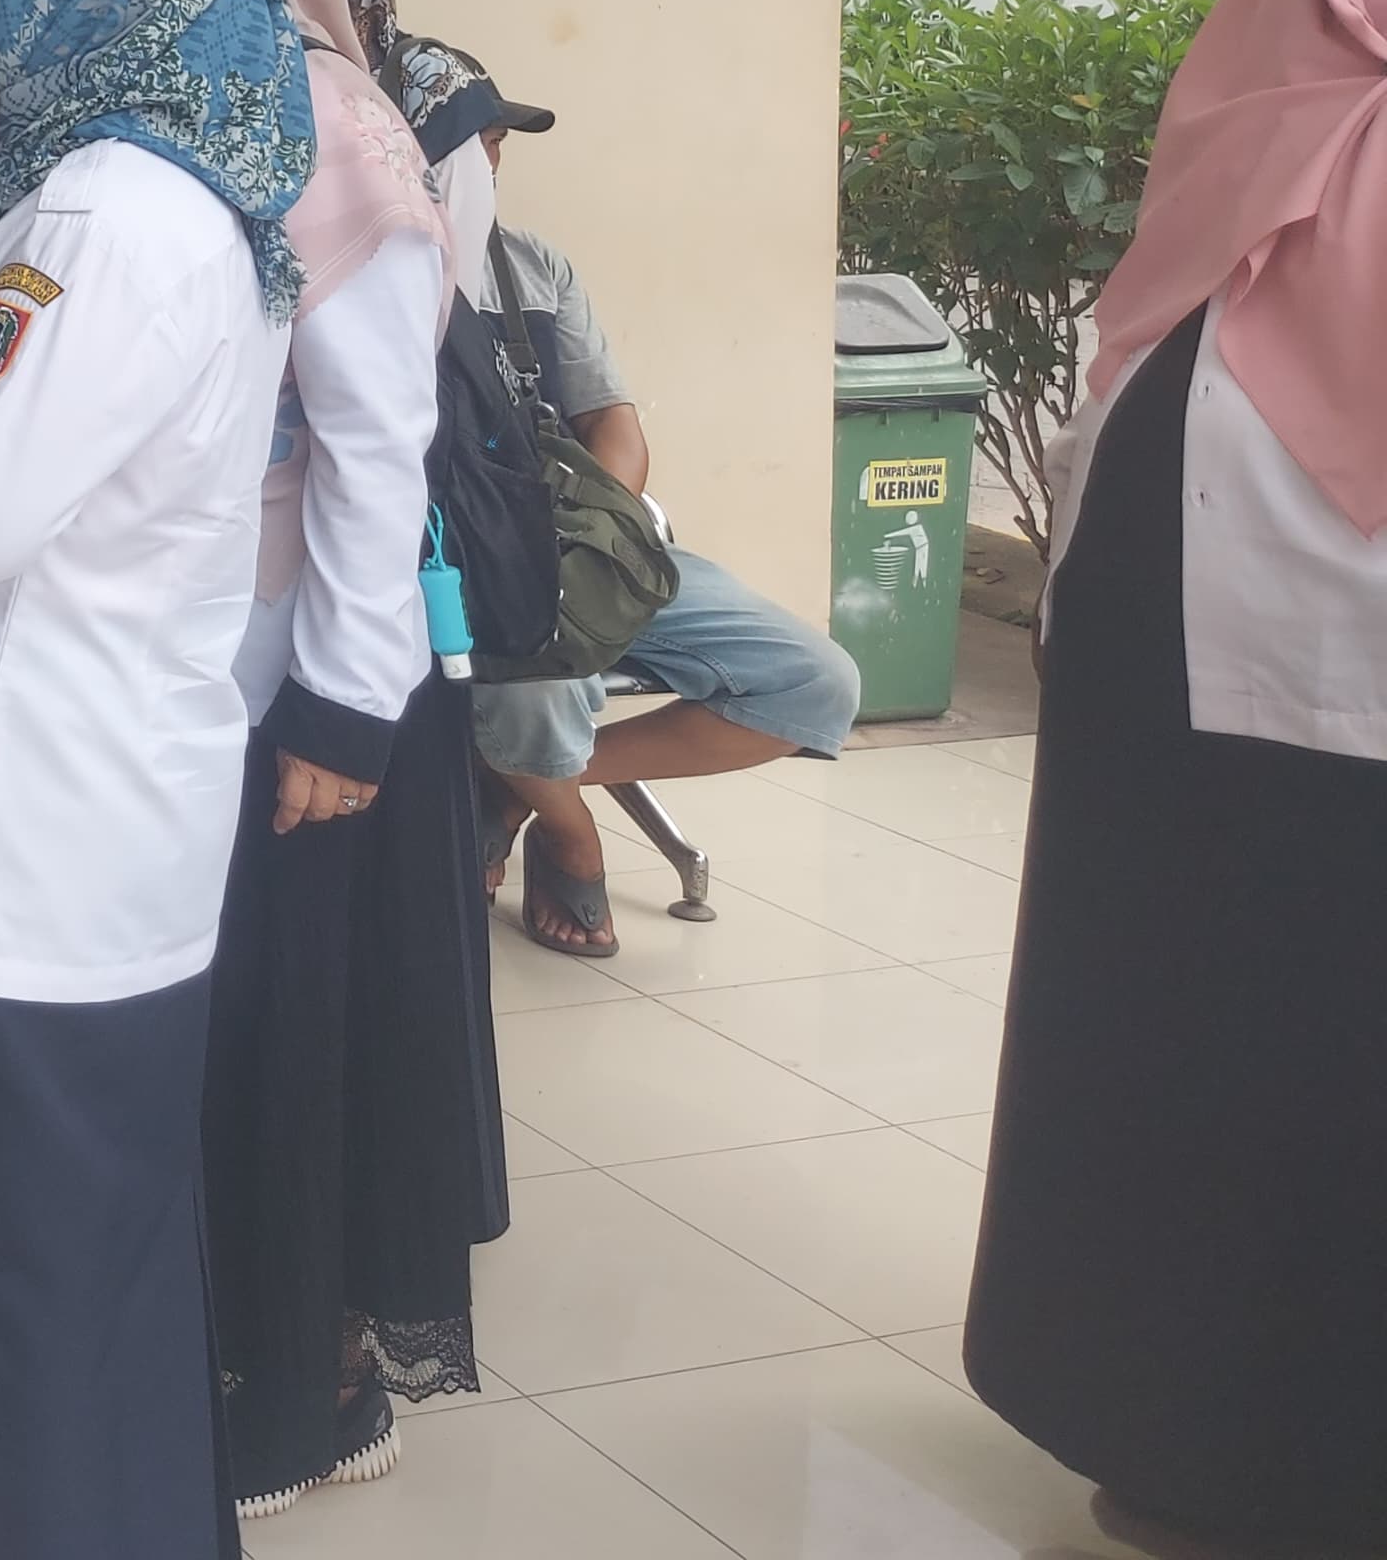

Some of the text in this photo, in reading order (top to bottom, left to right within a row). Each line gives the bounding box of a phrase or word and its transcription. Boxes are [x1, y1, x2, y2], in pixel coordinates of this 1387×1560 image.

[874, 464, 942, 479] TEMPAT SAMPAH
[875, 479, 939, 501] KERING
